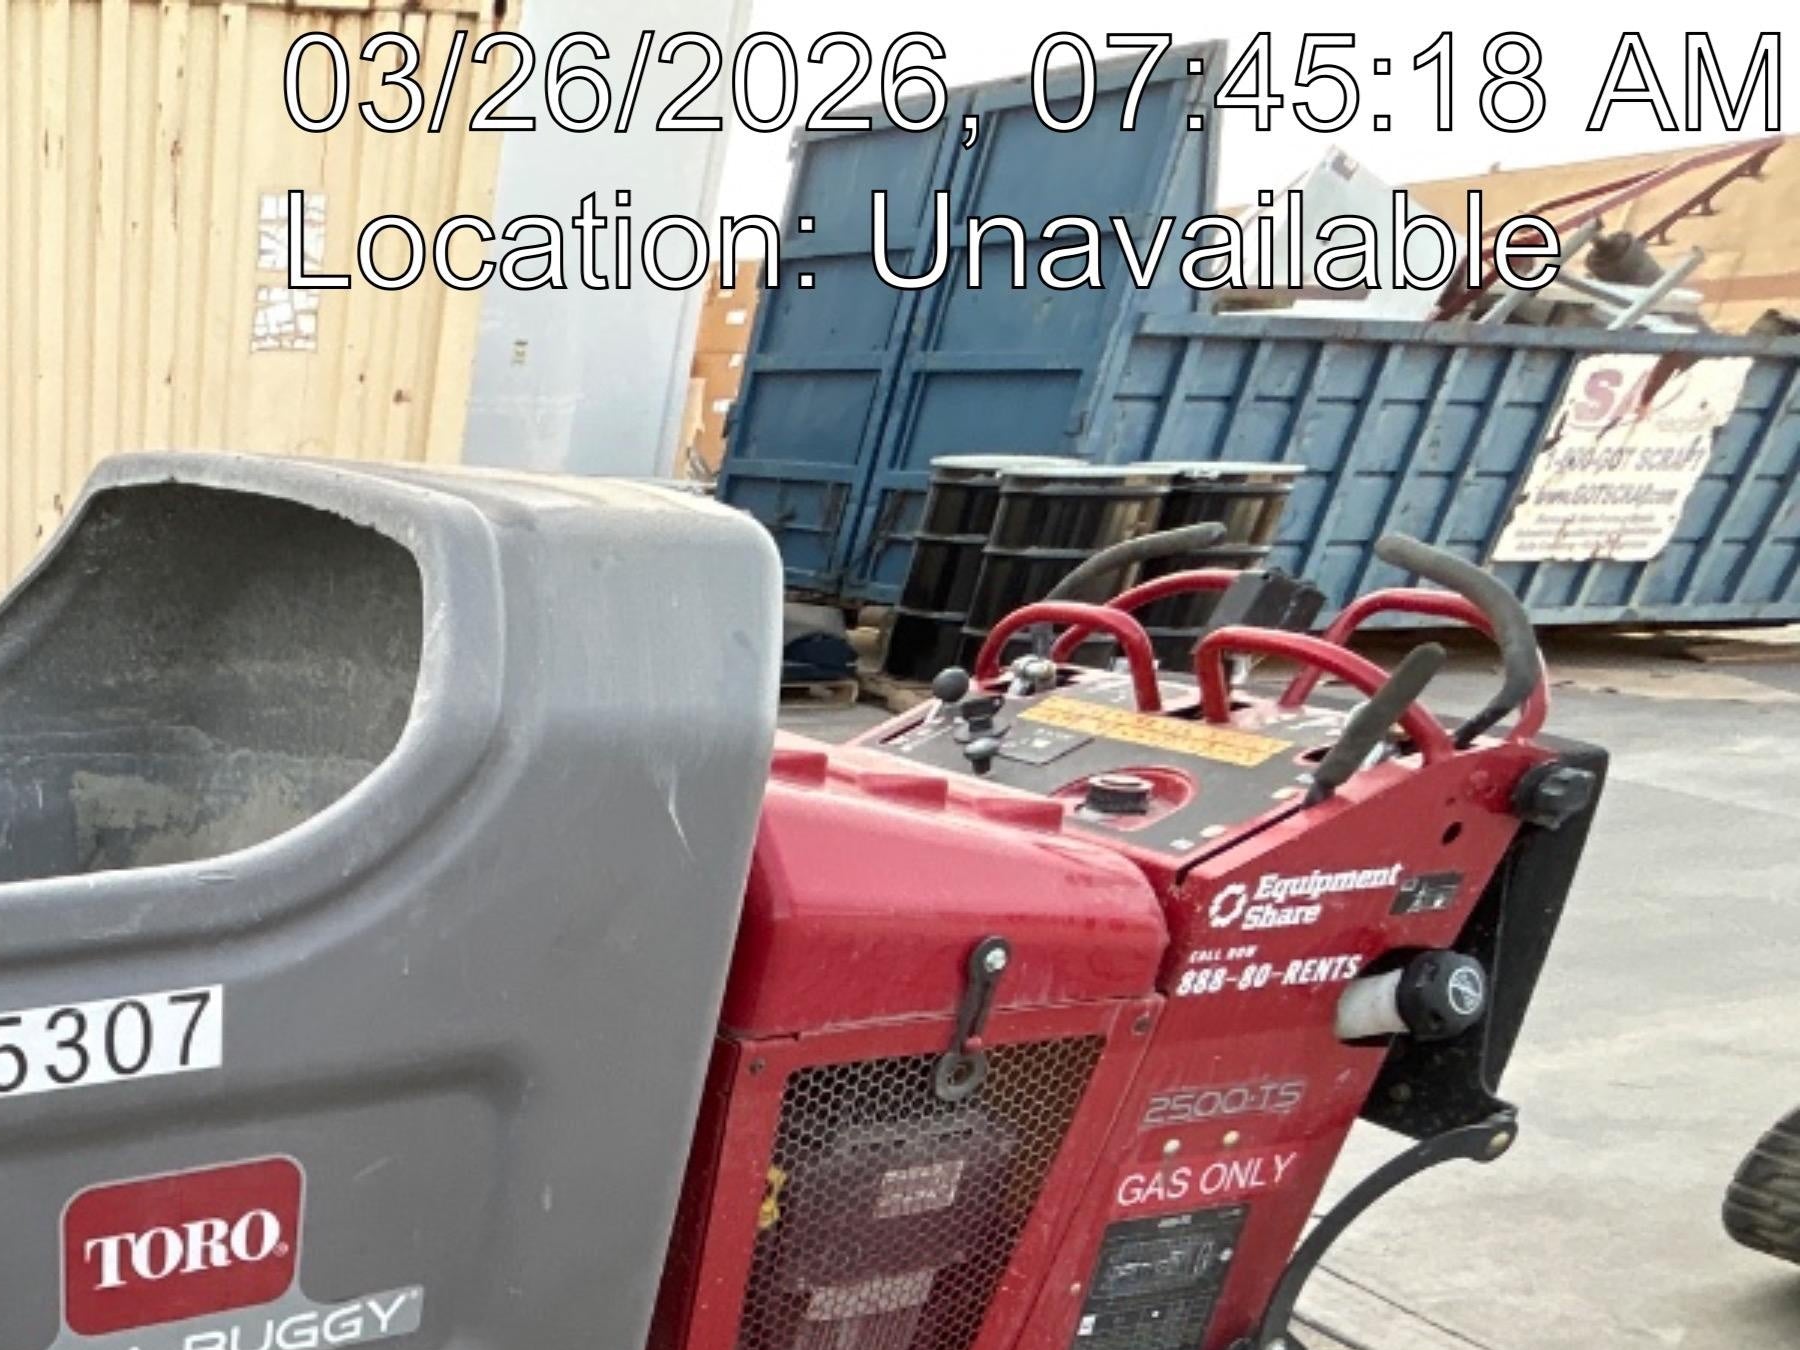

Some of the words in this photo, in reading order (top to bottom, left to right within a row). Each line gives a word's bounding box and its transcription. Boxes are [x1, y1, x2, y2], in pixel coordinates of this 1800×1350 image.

[1254, 863, 1403, 903] Equipment
[1242, 903, 1322, 930] Share
[1189, 949, 1222, 964] CALL
[1227, 945, 1258, 961] NOW
[1176, 955, 1363, 996] 888-80-RENTS
[1118, 1166, 1193, 1206] GAS
[1199, 1151, 1297, 1195] ONLY
[84, 1208, 282, 1291] TORO
